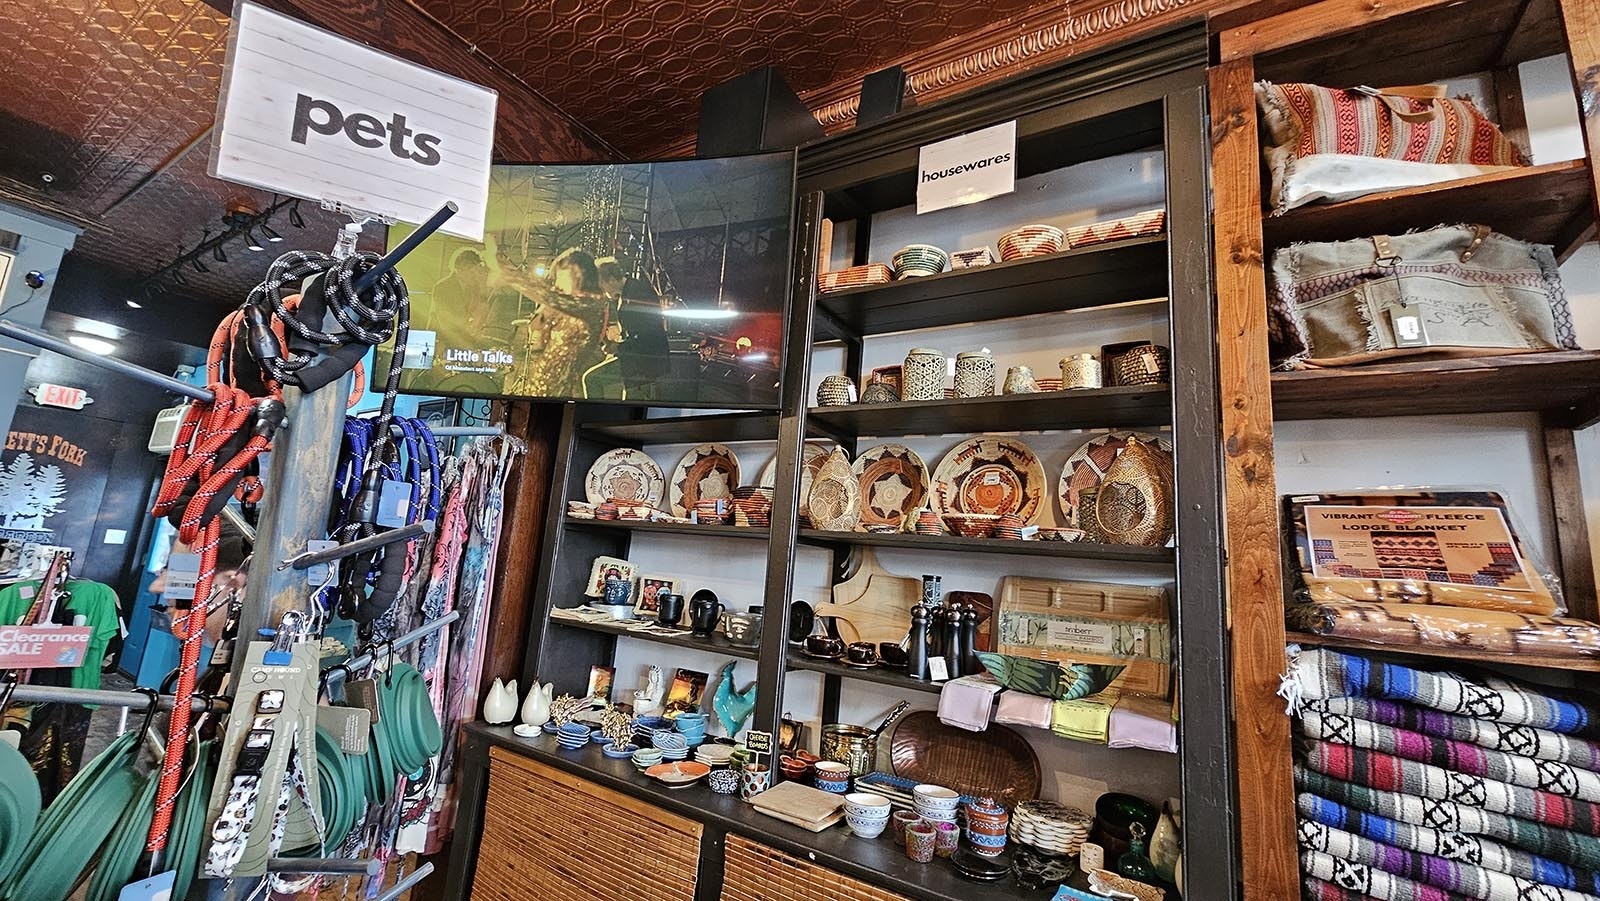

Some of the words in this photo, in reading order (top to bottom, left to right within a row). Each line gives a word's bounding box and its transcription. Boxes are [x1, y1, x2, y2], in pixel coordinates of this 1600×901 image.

[291, 93, 442, 166] pets
[921, 152, 1011, 183] housewares
[446, 349, 479, 362] Little
[482, 350, 513, 364] Talks
[45, 385, 81, 406] EXIT
[0, 629, 90, 642] Clearance
[0, 642, 44, 655] SALE
